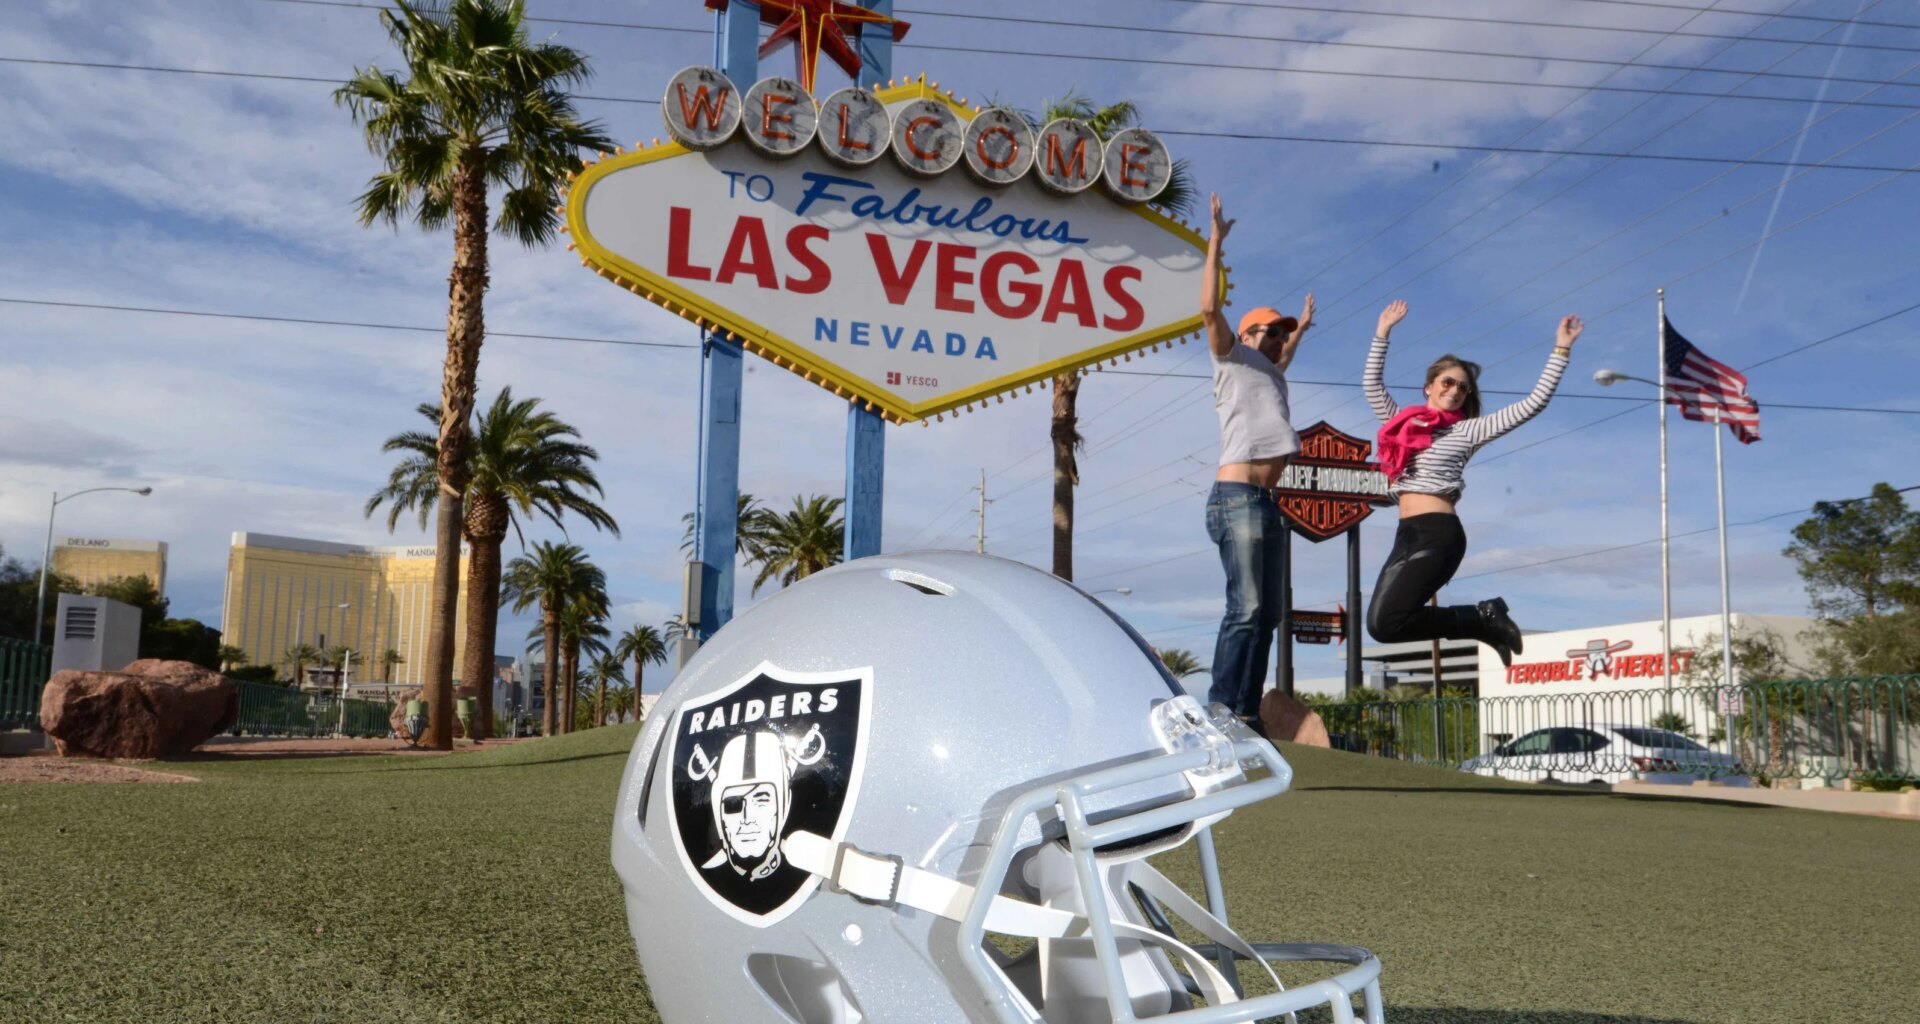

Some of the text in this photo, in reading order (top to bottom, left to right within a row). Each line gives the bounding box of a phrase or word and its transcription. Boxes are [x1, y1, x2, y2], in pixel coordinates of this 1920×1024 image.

[677, 82, 1152, 188] WELCOME
[722, 170, 1090, 245] TO Fabulous
[666, 206, 1146, 333] LAS VEGAS
[814, 316, 999, 361] NEVADA
[906, 375, 938, 388] YESCO
[67, 538, 110, 548] DELANO
[1505, 659, 1584, 685] TERRIBLE
[689, 688, 839, 735] RAIDERS
